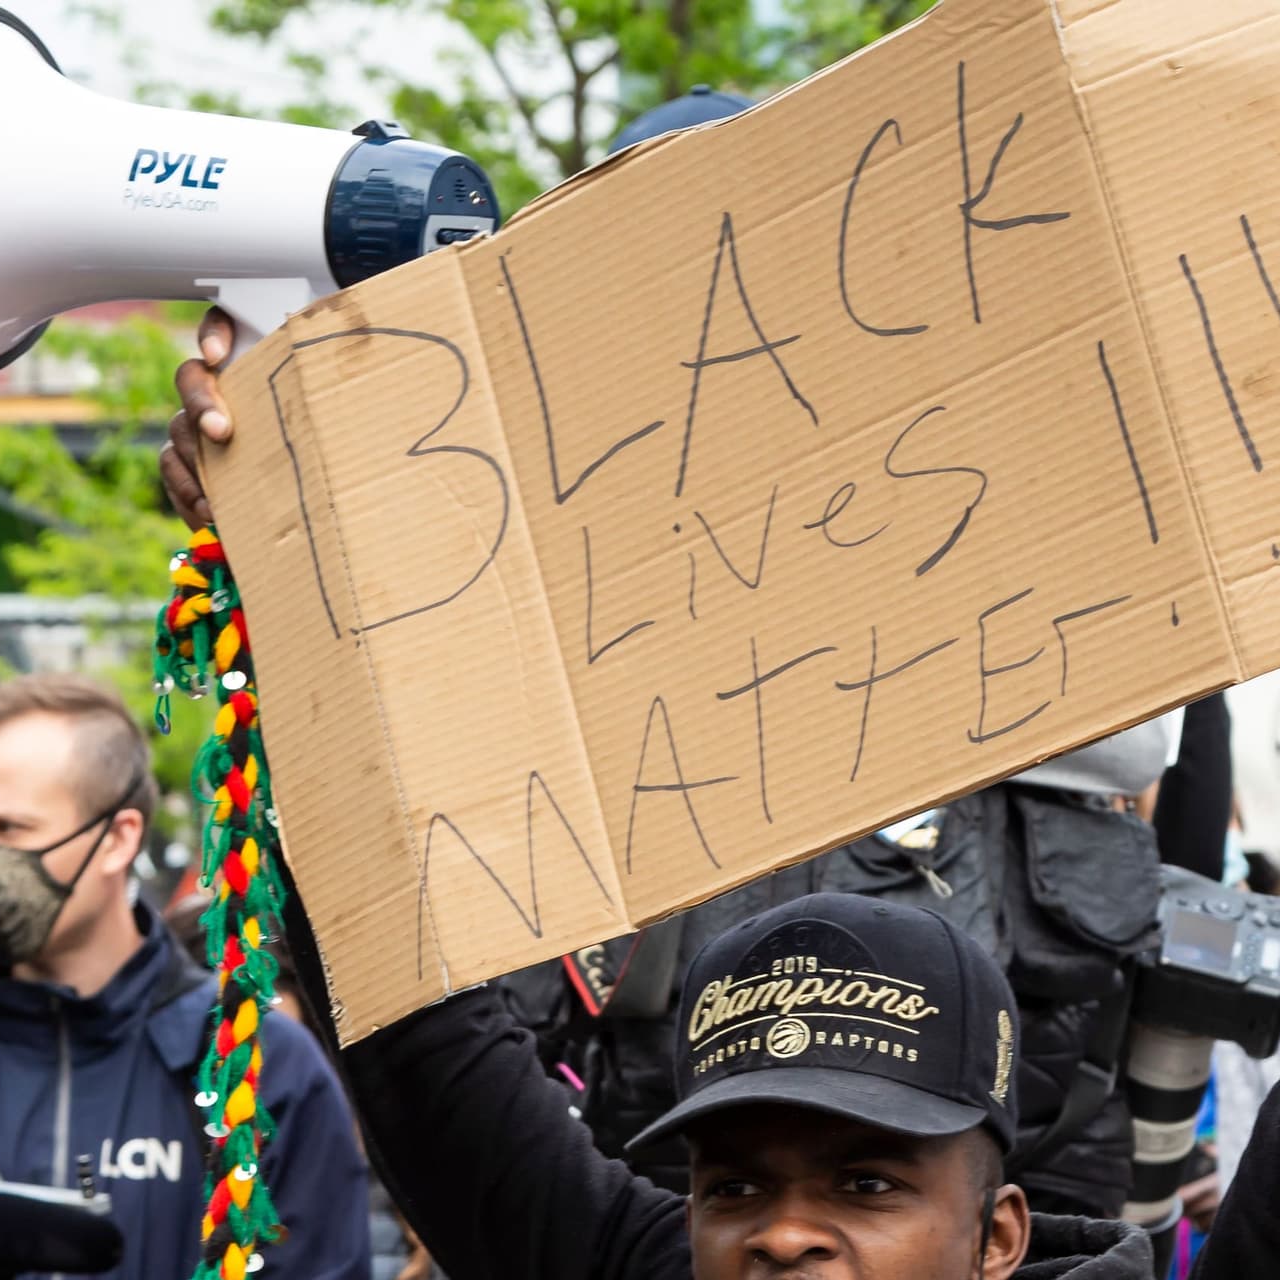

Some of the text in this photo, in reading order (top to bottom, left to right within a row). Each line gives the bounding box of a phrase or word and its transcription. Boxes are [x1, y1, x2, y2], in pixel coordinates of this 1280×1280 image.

[128, 148, 228, 189] PYLE
[266, 58, 1072, 642] BLACK
[771, 956, 818, 976] 2019
[688, 975, 940, 1043] Champions
[815, 1030, 920, 1063] RAPTORS
[99, 1138, 182, 1182] LCN
